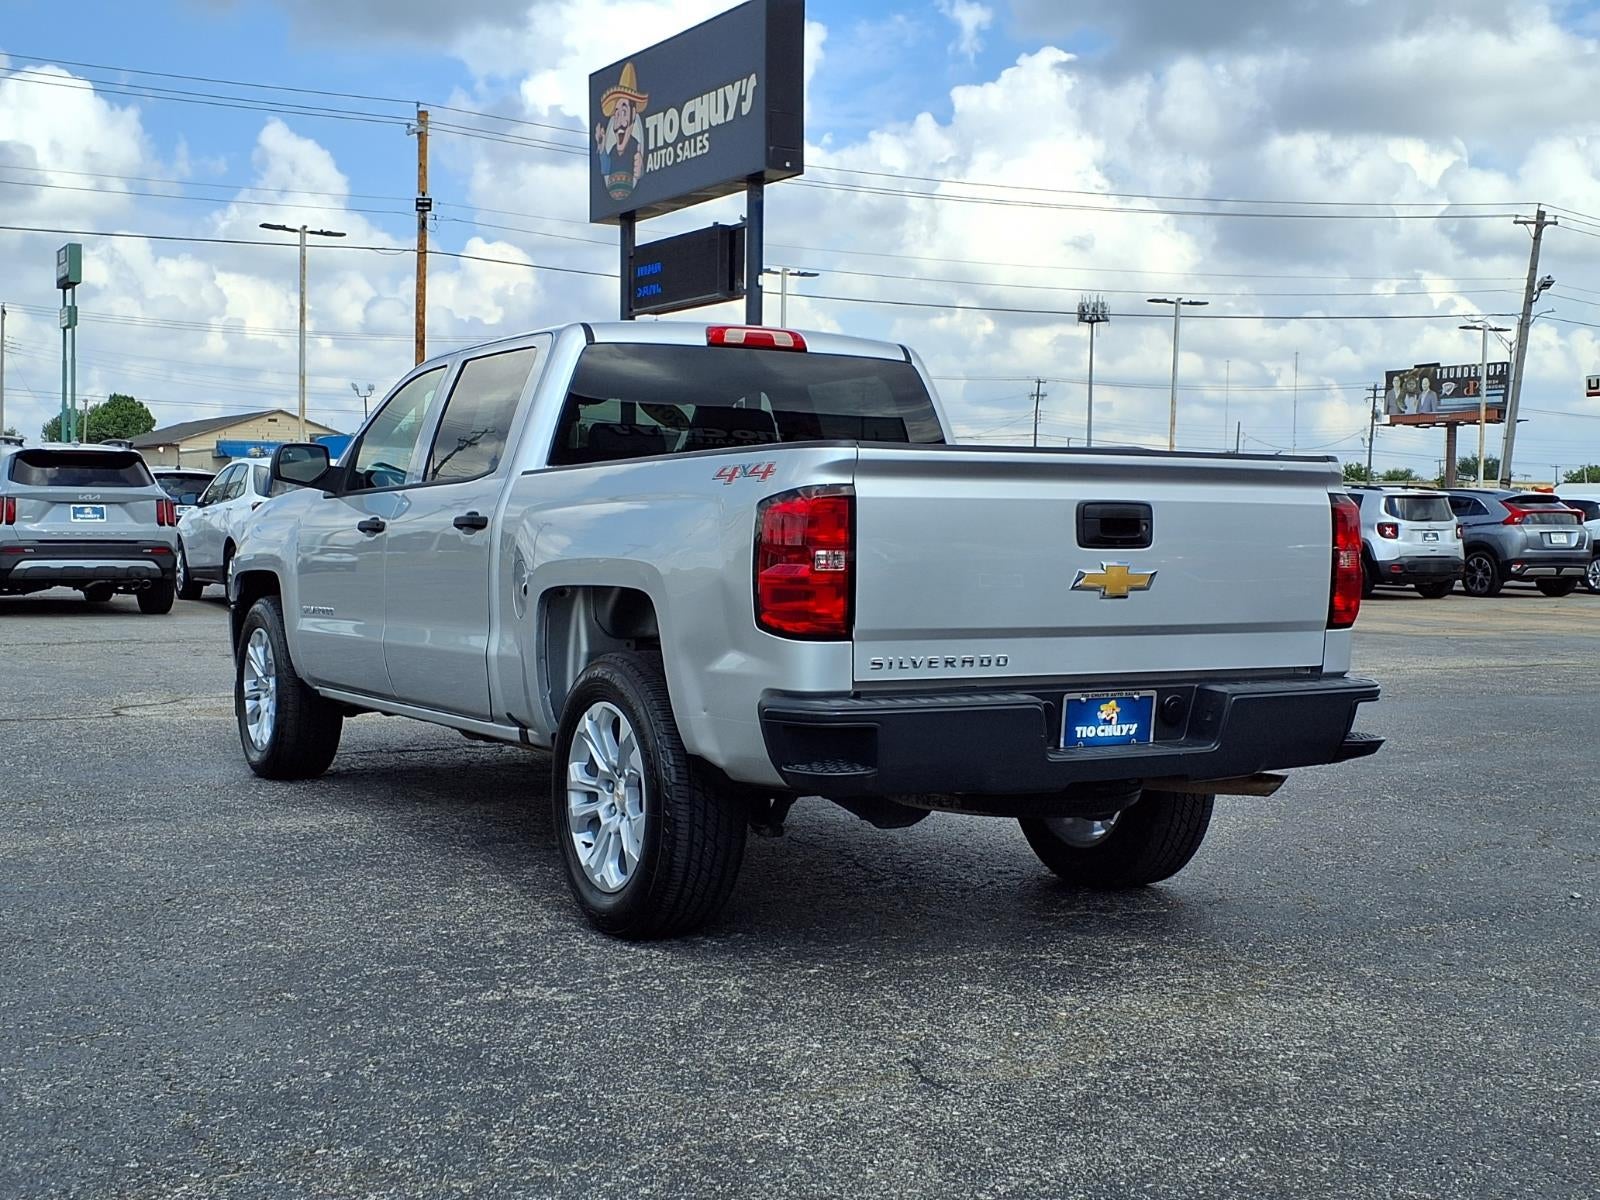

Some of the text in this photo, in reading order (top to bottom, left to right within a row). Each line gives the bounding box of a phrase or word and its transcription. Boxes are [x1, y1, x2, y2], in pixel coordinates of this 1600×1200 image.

[645, 73, 757, 150] TIO CHUY'S
[646, 133, 709, 173] AUTO SALES
[1489, 364, 1507, 375] UP!
[870, 654, 1009, 670] SILVERADO
[1075, 723, 1138, 738] TIO CHUY'S
